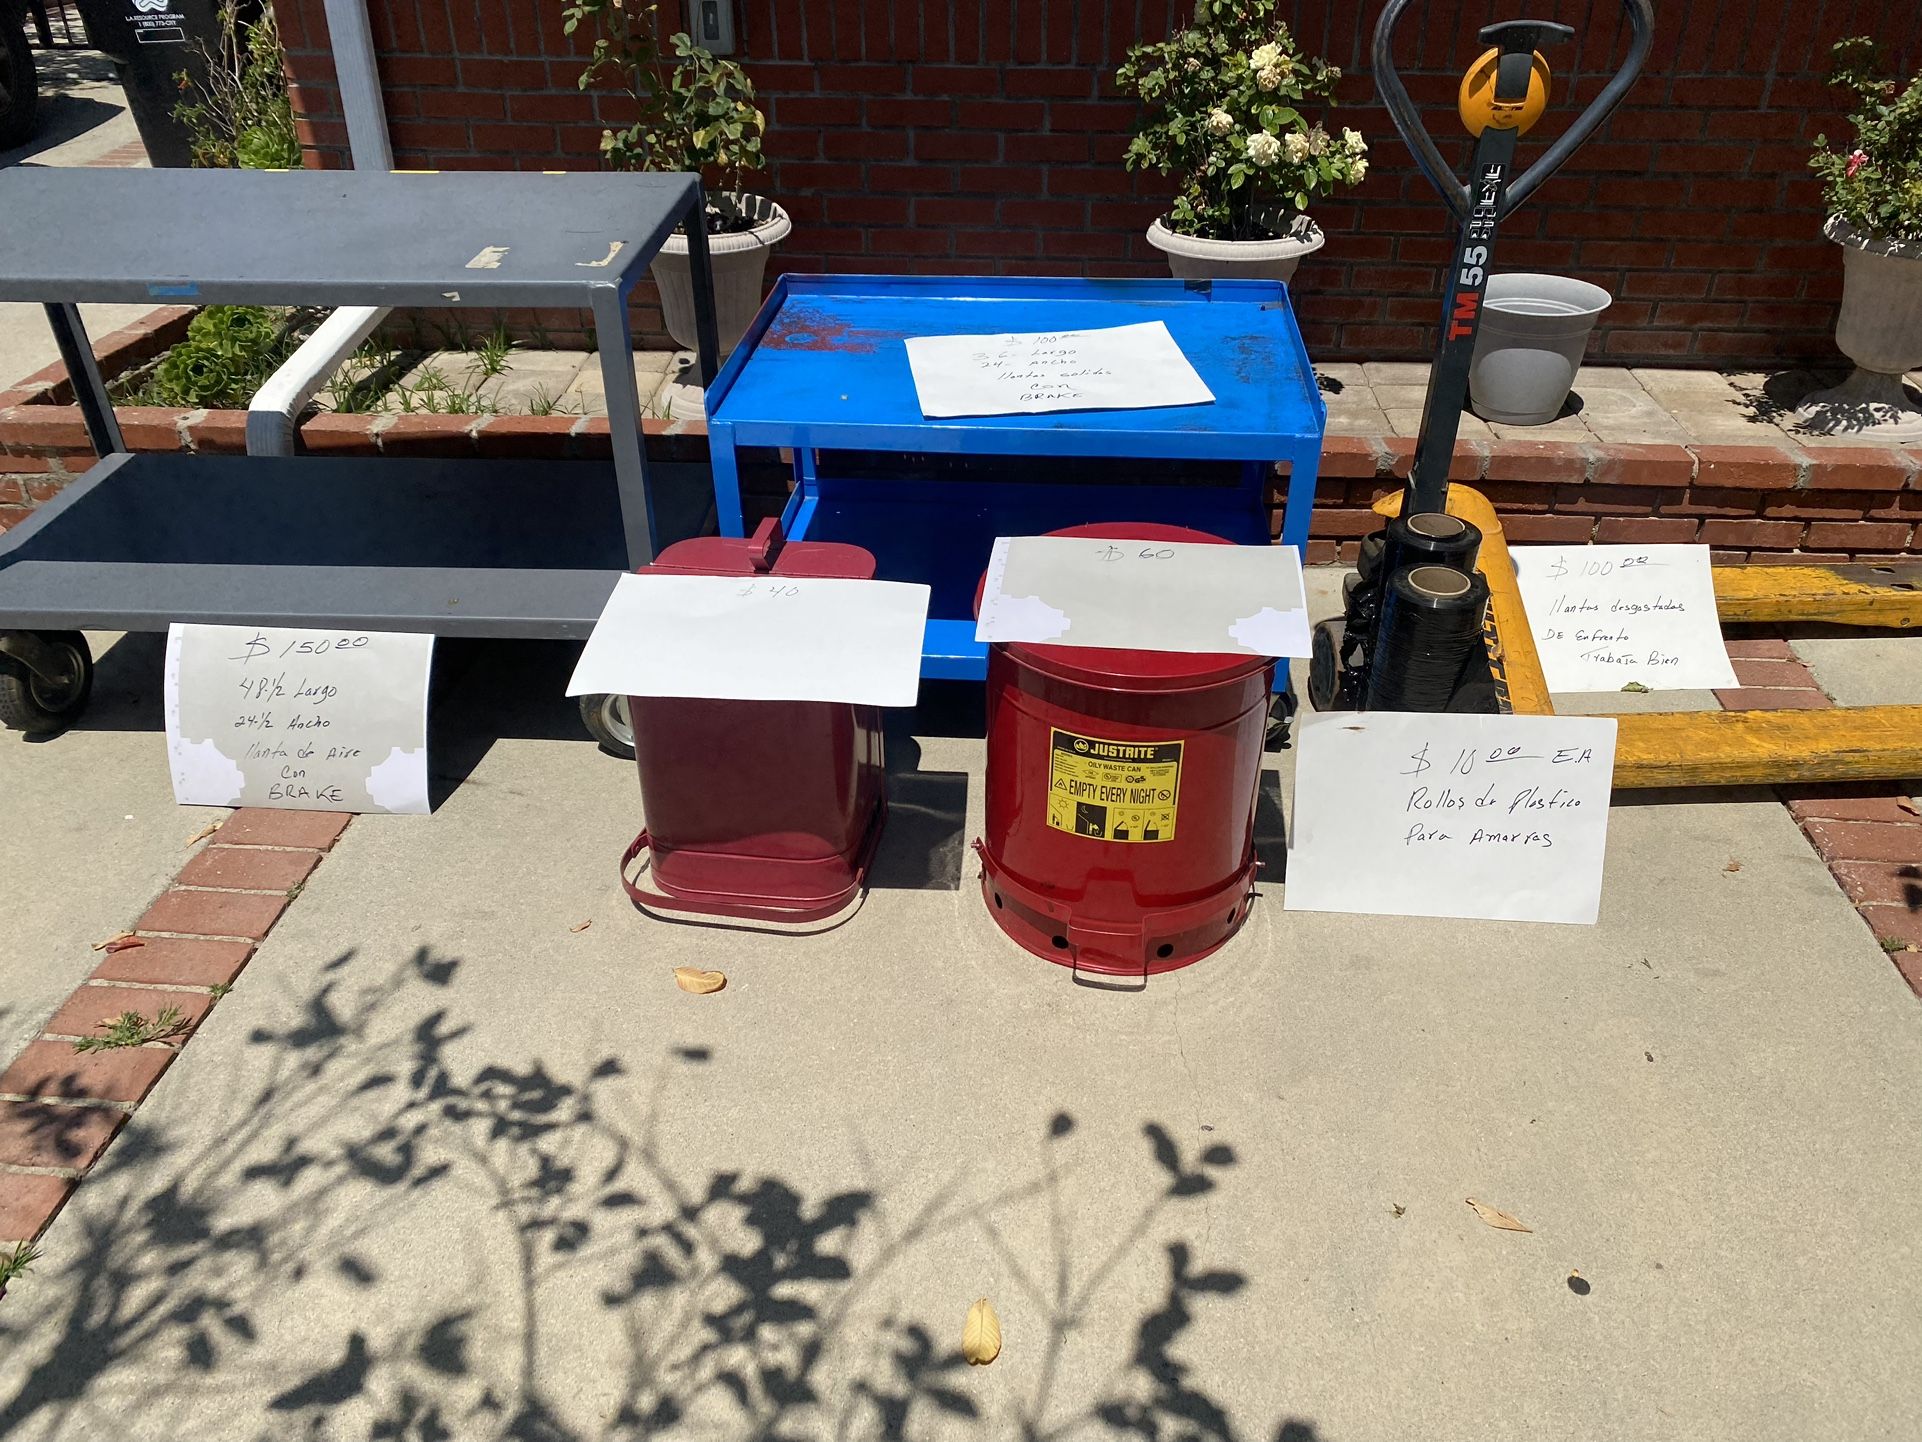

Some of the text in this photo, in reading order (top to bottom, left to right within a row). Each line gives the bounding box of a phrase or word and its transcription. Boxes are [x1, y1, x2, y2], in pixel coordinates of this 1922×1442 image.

[1448, 245, 1488, 341] TM 55
[1019, 392, 1084, 401] BRAKE
[1541, 628, 1564, 640] DE
[1647, 650, 1679, 665] Bien
[293, 677, 337, 705] Largo
[286, 714, 330, 730] Ancho
[325, 746, 361, 760] Aire
[1090, 743, 1155, 759] JUSTRITE
[1088, 760, 1102, 769] OILY
[1103, 763, 1125, 772] WASTE
[268, 782, 344, 803] BRAKE
[1069, 779, 1156, 804] EMPTY EVERY NIGHT
[1406, 786, 1465, 812] Rollos
[1469, 828, 1553, 848] Amarras
